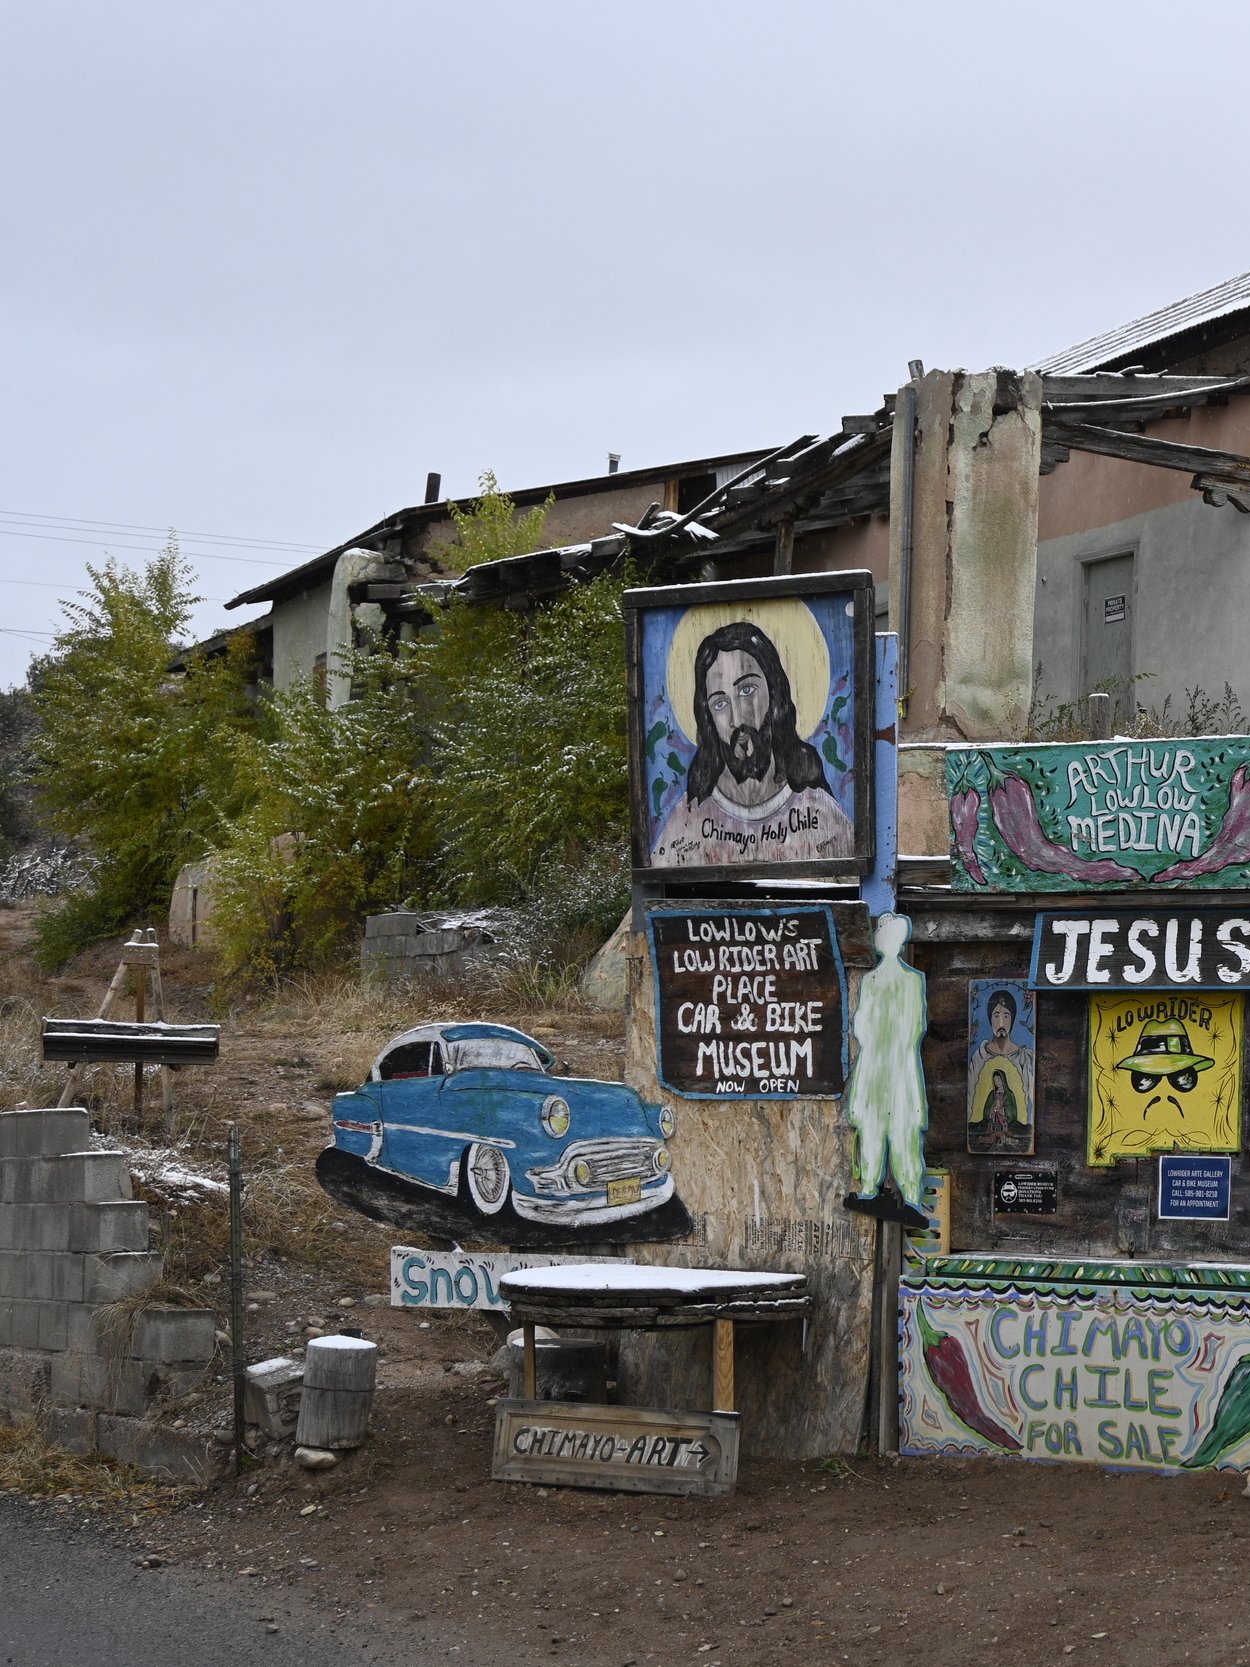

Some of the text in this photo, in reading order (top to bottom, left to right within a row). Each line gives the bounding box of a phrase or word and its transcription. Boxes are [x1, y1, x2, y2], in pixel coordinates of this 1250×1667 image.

[1065, 747, 1199, 809] ARTHUR
[702, 818, 756, 854] Chimayo
[761, 822, 788, 844] Holy
[1067, 811, 1200, 858] MEDINA
[782, 939, 823, 971] ART
[712, 975, 778, 1005] PLACE
[678, 1002, 824, 1034] CAR & BIKE
[1116, 997, 1214, 1032] LOWRIDER
[696, 1038, 813, 1078] MUSEUM
[716, 1079, 800, 1094] NOW OPEN
[1191, 1170, 1202, 1178] ARTE
[1203, 1170, 1224, 1178] GALLERY
[1197, 1180, 1218, 1188] MUSEUM
[1187, 1200, 1219, 1208] APPOINTMENT
[990, 1306, 1193, 1362] CHIMAYO
[1018, 1364, 1183, 1418] CHILE
[1026, 1419, 1184, 1466] FOR SALE
